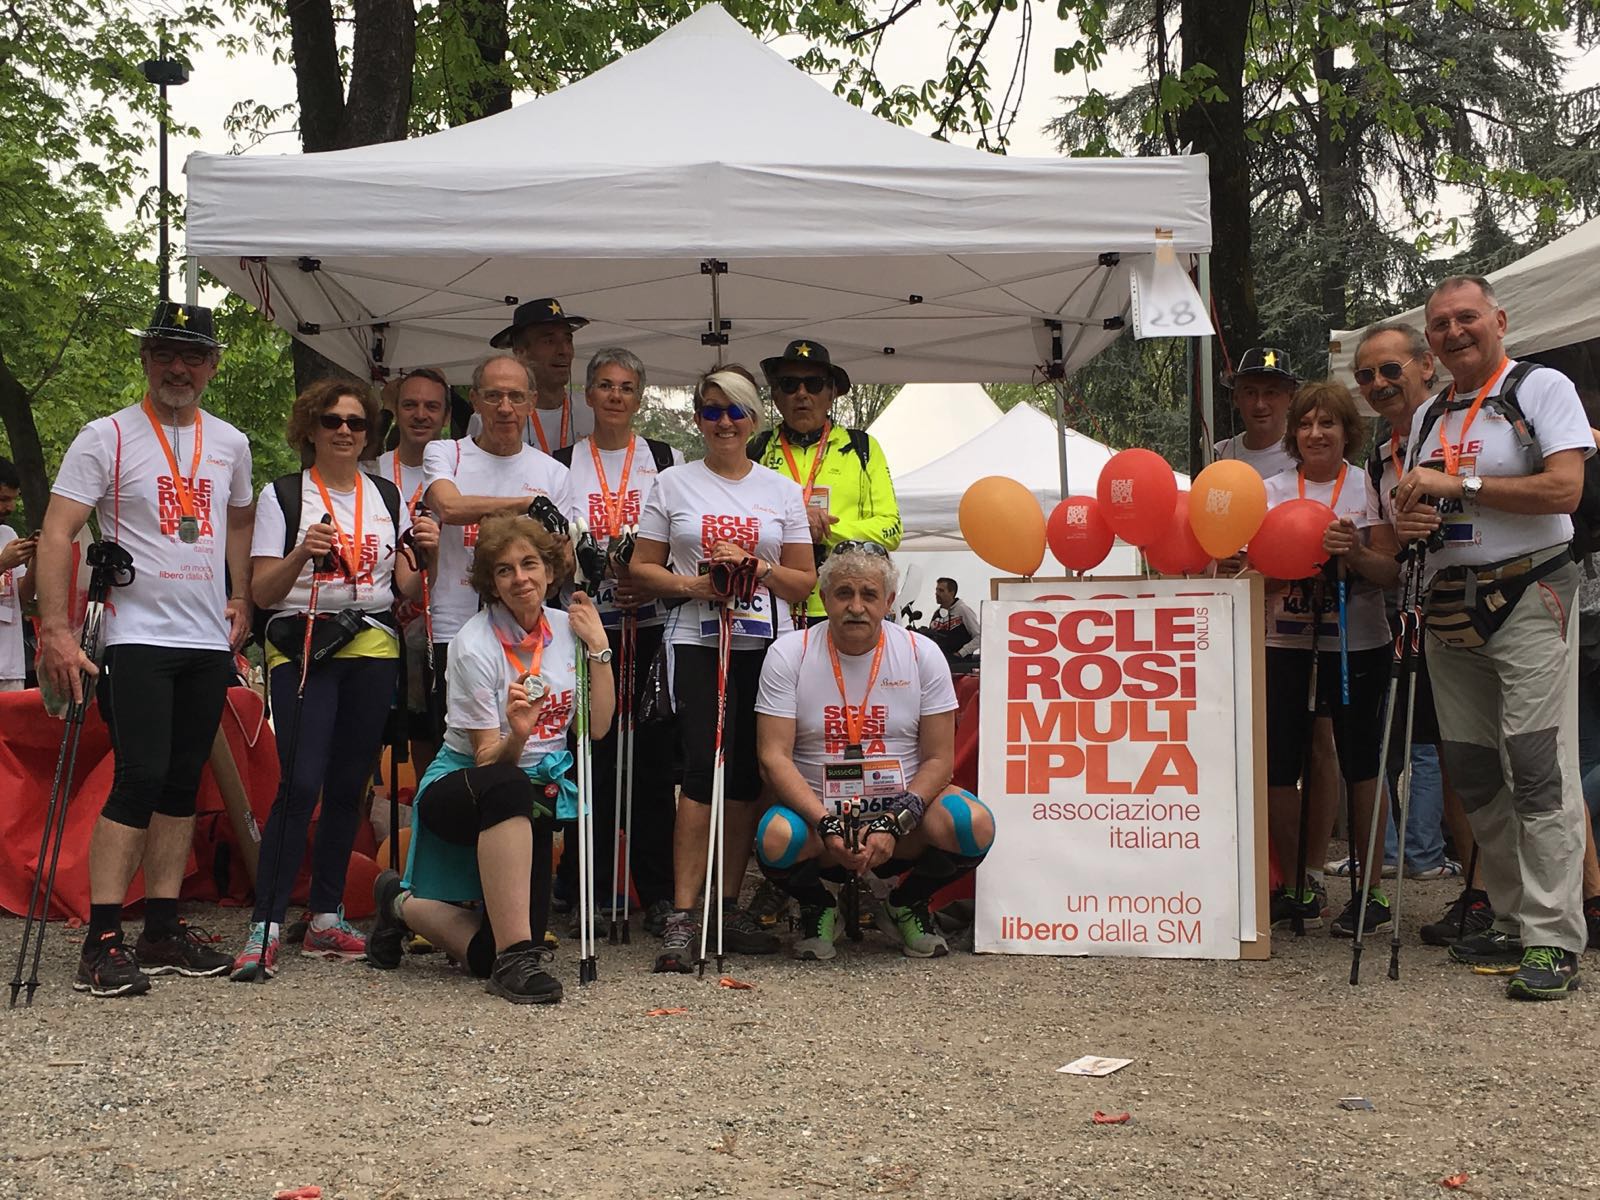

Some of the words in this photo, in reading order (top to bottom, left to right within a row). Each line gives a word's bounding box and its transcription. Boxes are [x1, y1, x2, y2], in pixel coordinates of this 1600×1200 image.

[1148, 300, 1197, 327] 28
[158, 490, 211, 509] RSi
[588, 500, 641, 517] RSi
[158, 505, 211, 521] MLT
[701, 514, 759, 528] SCLE
[159, 519, 214, 538] iPA
[701, 525, 760, 541] ROSi
[159, 570, 184, 581] libero
[1008, 607, 1196, 655] SCLE
[1197, 606, 1209, 651] ONLUS
[1007, 652, 1197, 700] ROSi
[1006, 700, 1197, 743] MULT
[825, 739, 887, 754] iPA
[1006, 743, 1199, 795] iPLA
[1032, 798, 1201, 822] associazione
[1110, 826, 1201, 850] italiana
[1067, 894, 1099, 913] un
[1108, 890, 1202, 915] mondo
[1001, 916, 1079, 941] libero
[1088, 919, 1149, 943] dalla
[1157, 919, 1202, 945] SM
